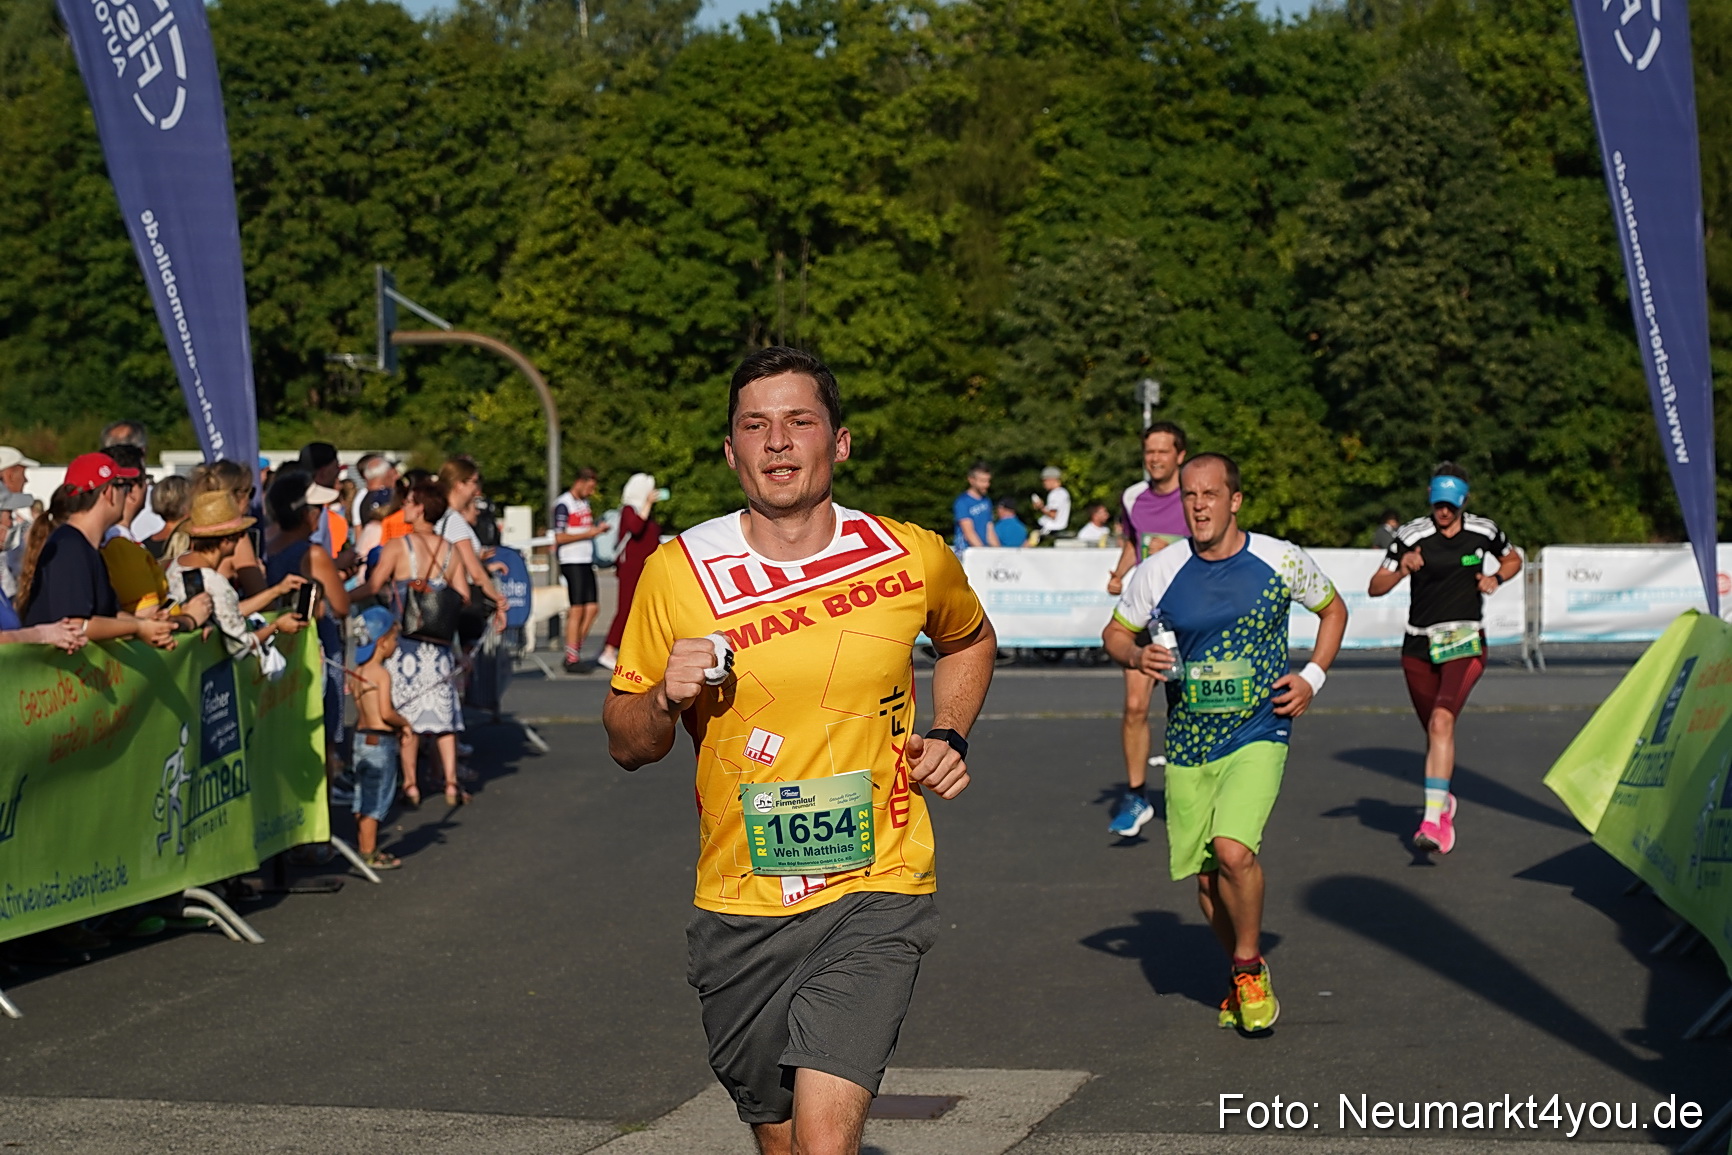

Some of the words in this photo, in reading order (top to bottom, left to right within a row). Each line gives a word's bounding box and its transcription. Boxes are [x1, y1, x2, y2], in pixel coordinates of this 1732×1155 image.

[723, 606, 817, 653] MAX
[822, 569, 924, 619] BÖGL
[1201, 679, 1236, 697] 846
[775, 795, 816, 808] Firmenlauf
[753, 825, 768, 857] RUN
[767, 807, 857, 845] 1654
[858, 808, 871, 853] 2022
[773, 846, 800, 858] Weh
[803, 843, 855, 858] Matthias
